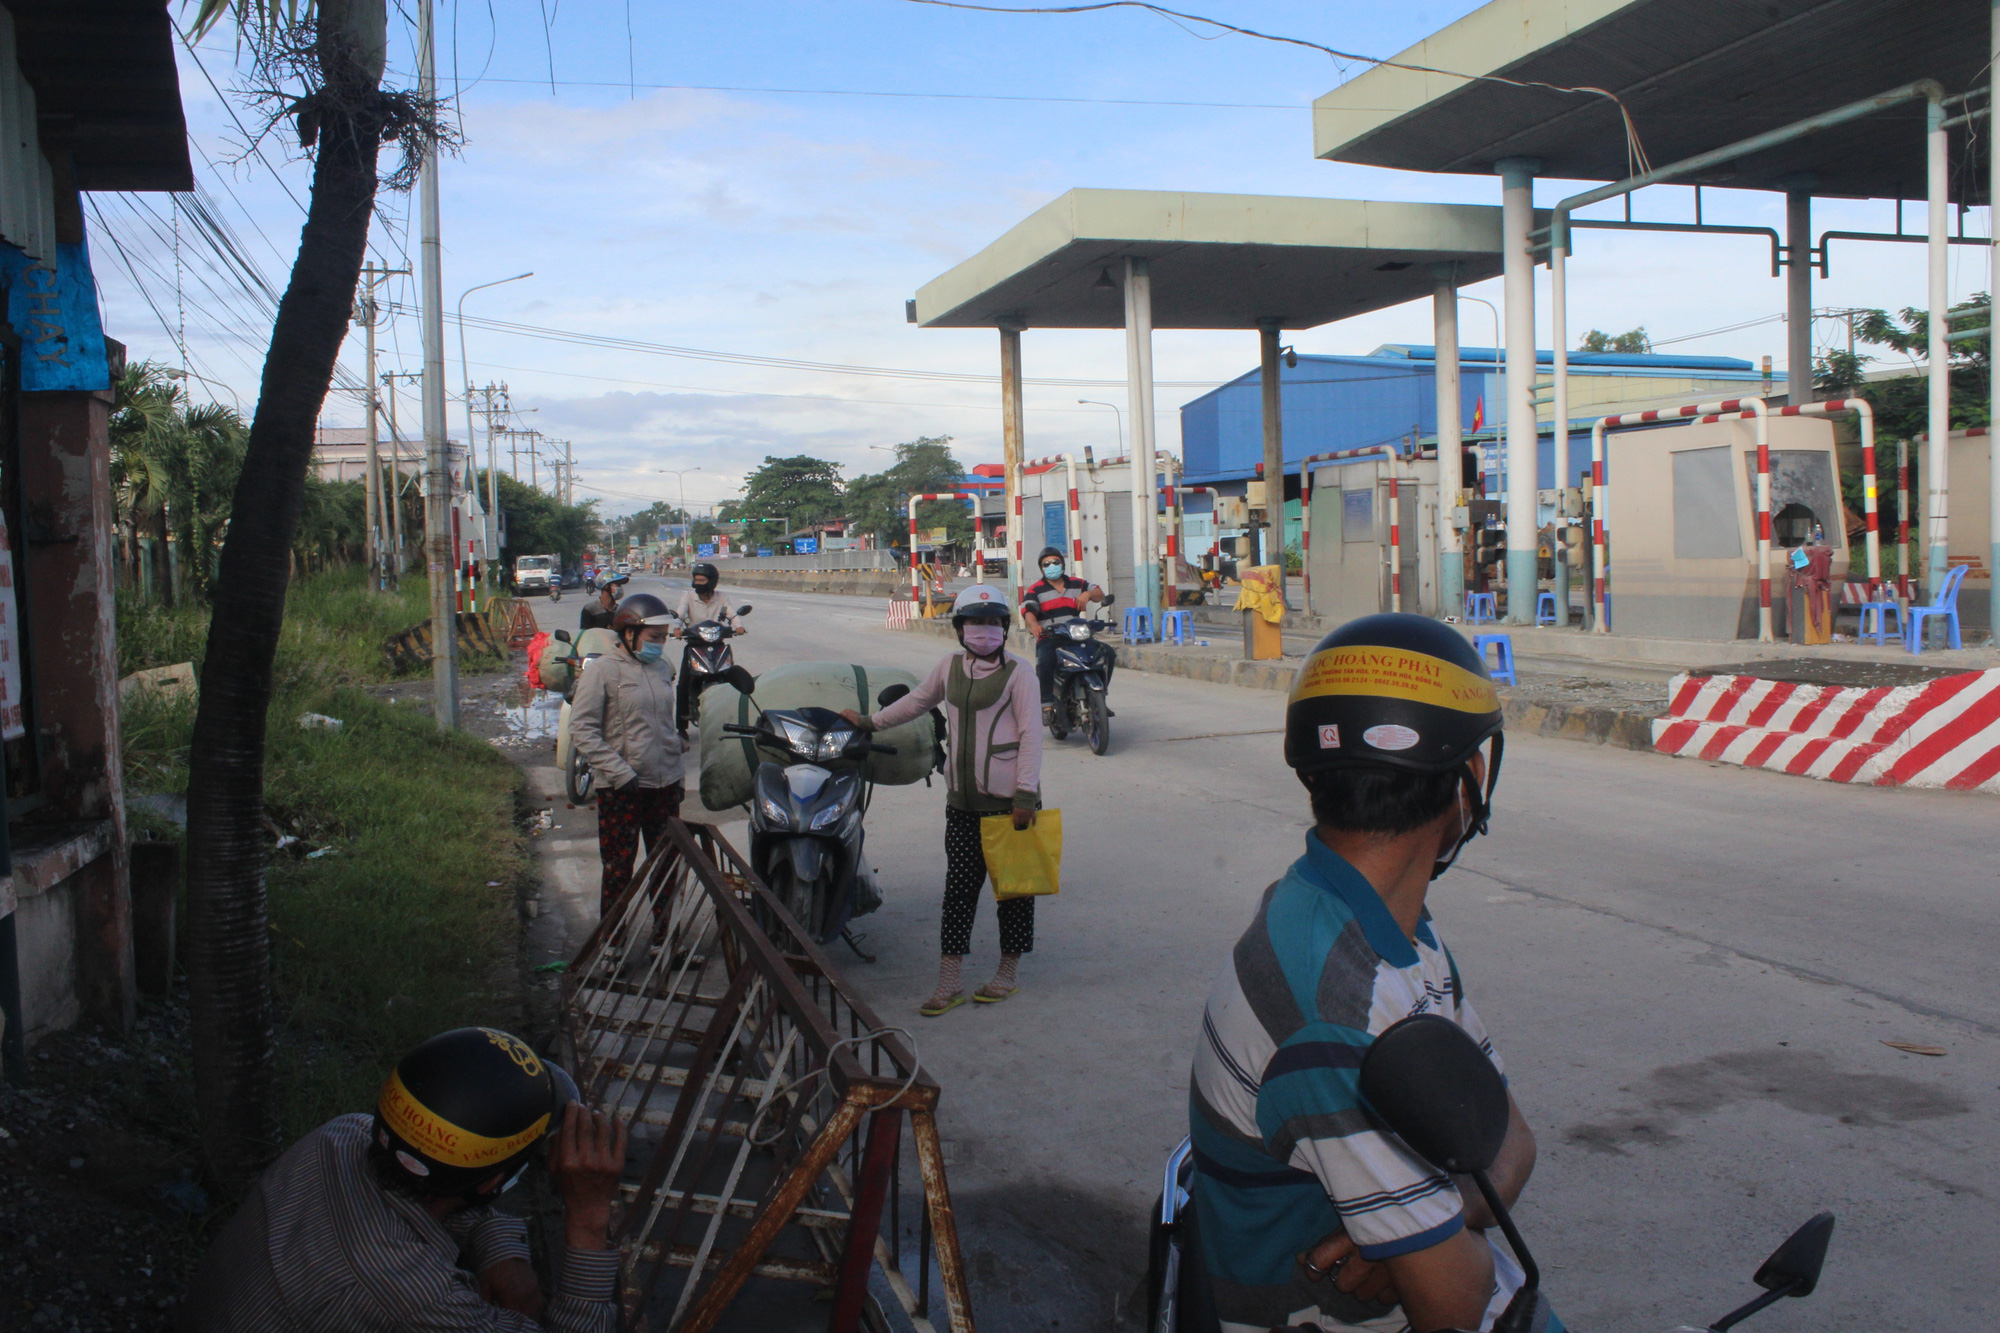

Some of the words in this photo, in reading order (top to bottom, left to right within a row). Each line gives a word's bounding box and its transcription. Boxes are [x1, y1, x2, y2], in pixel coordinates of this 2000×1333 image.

[22, 263, 70, 369] CHẠY
[1334, 651, 1392, 667] HOÀNG
[1398, 656, 1443, 678] PHÁT
[403, 1103, 459, 1147] HOÀNG
[463, 1145, 498, 1161] VÀNG
